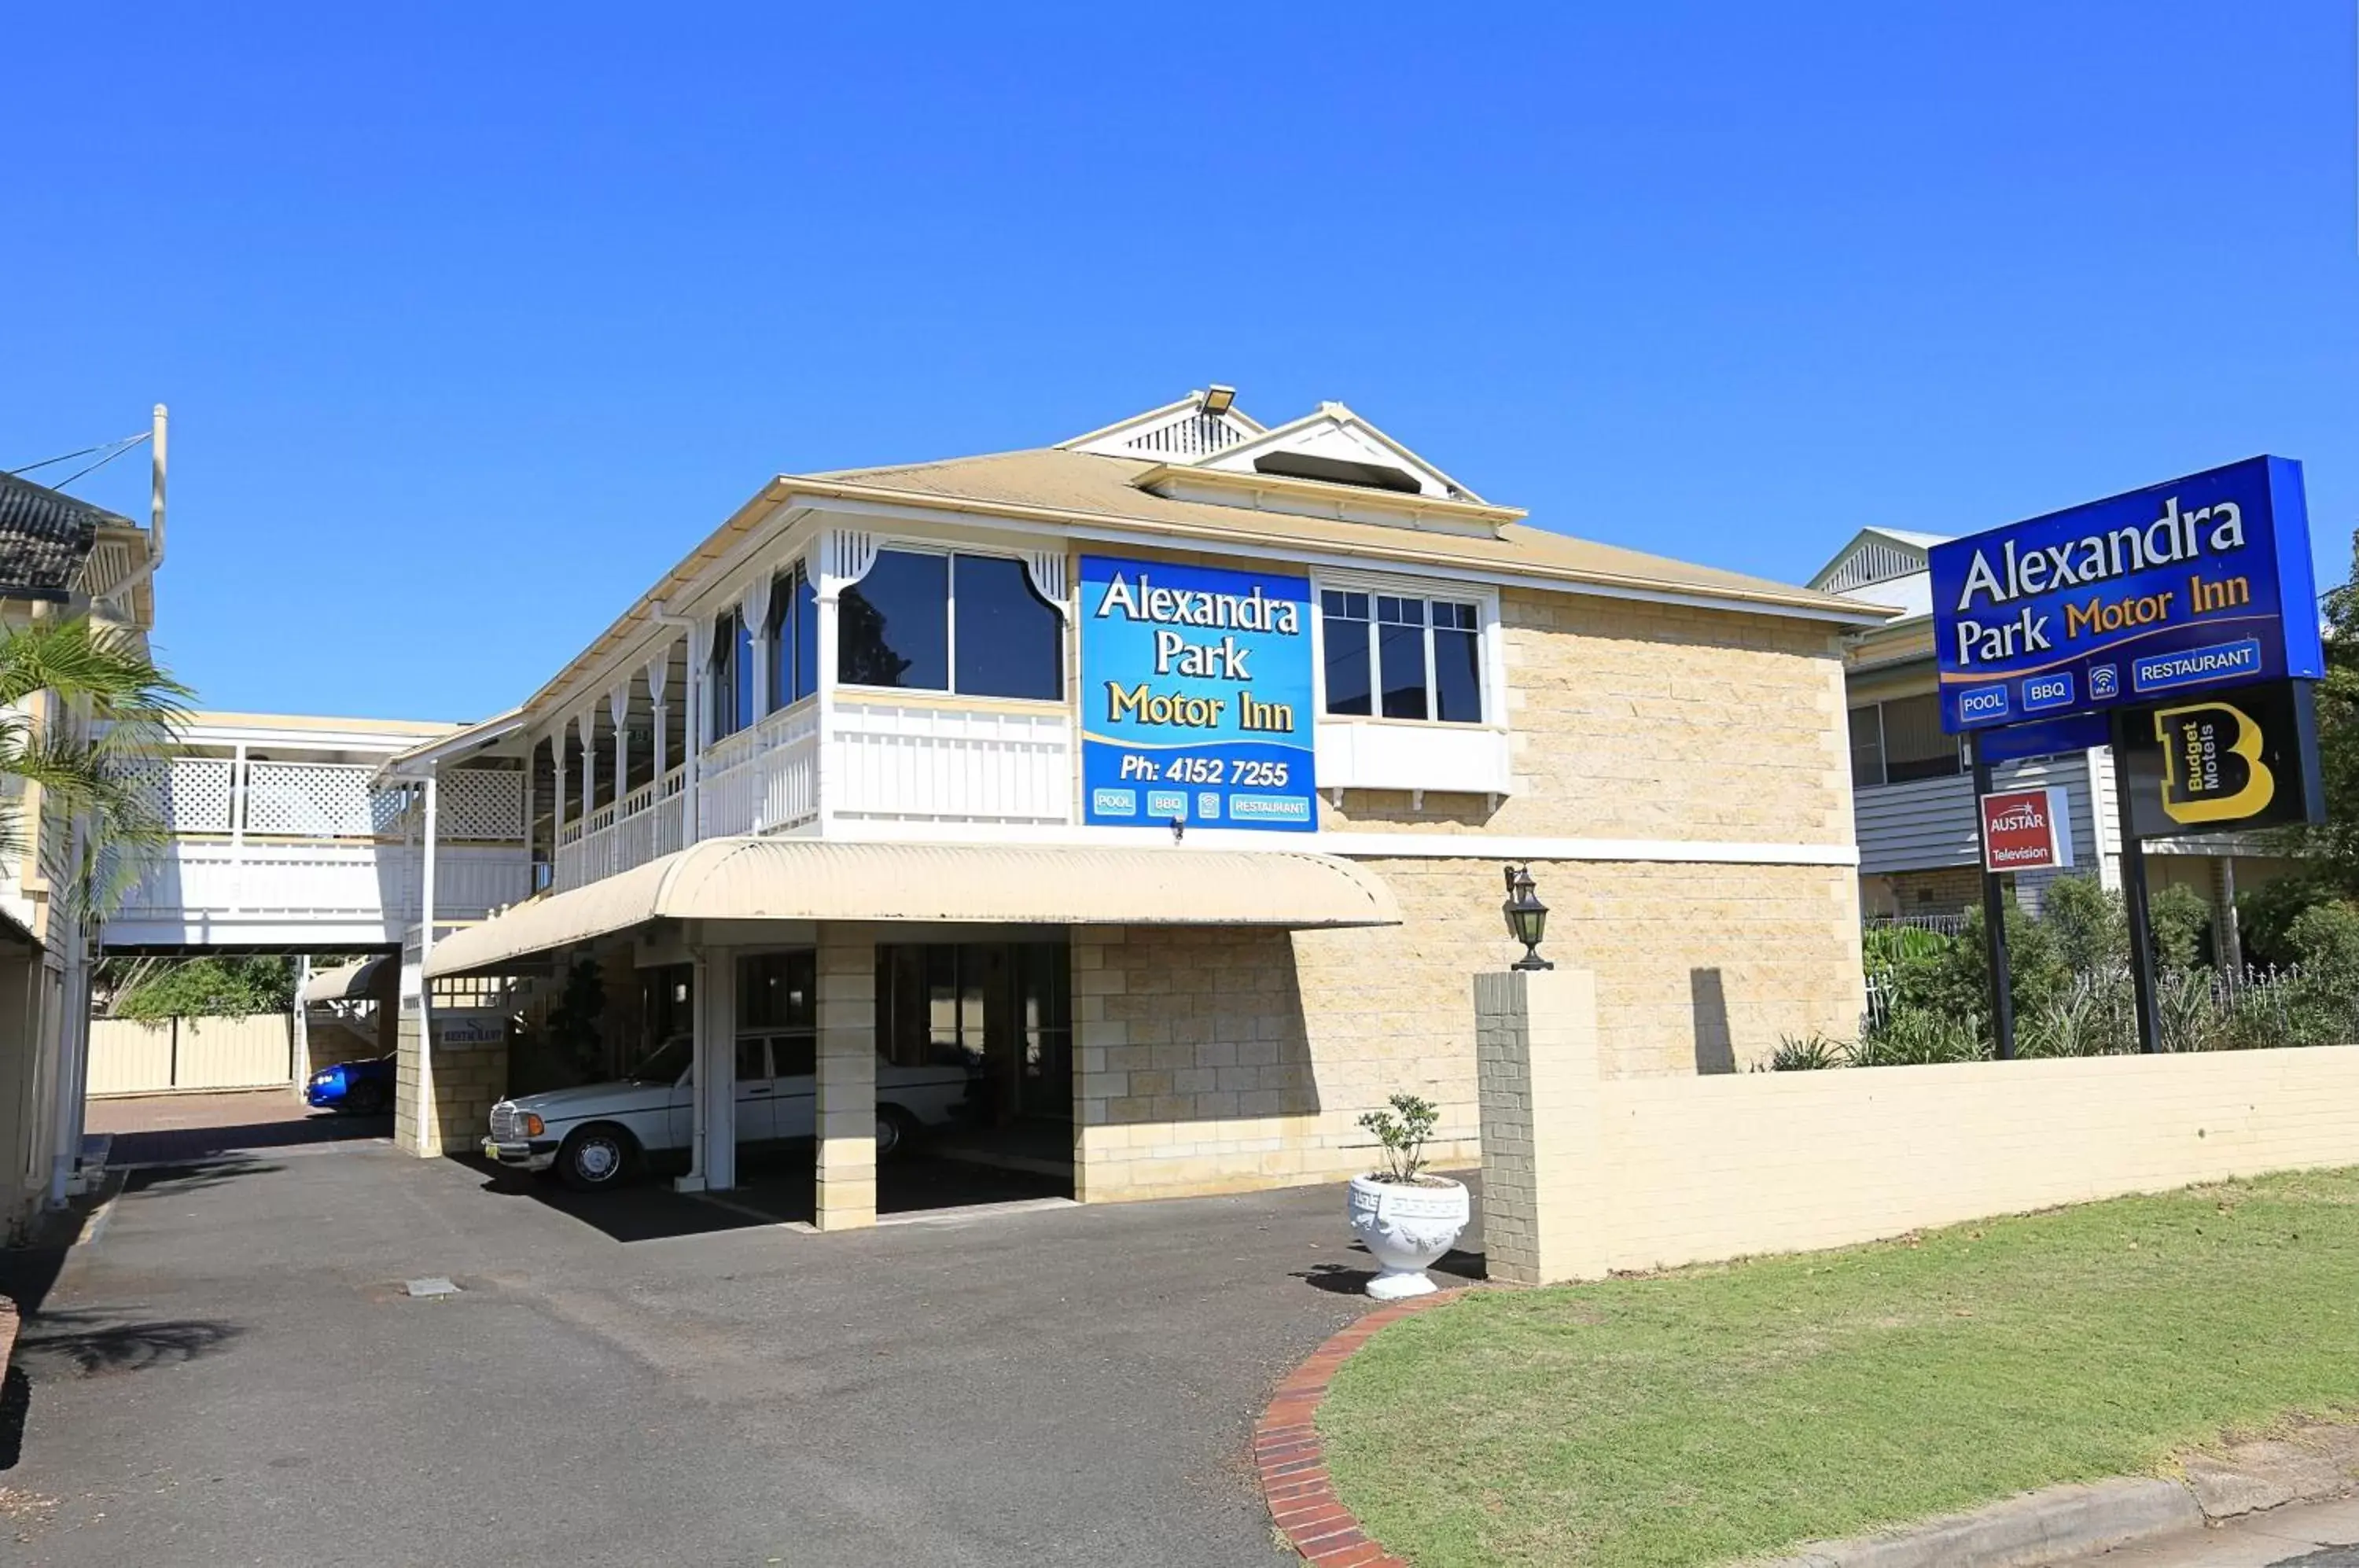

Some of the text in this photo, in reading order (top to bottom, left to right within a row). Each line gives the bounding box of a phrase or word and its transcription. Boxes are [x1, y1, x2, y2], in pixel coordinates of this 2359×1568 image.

[1958, 497, 2245, 610] Alexandra
[1095, 571, 1299, 635] Alexandra
[1956, 576, 2250, 666] Park Motor Inn
[1154, 630, 1253, 681] Park
[2141, 649, 2254, 681] RESTAURANT
[1964, 692, 2005, 713] POOL
[2030, 678, 2066, 701] BBQ
[1104, 681, 1295, 733] Motor Inn
[1120, 755, 1290, 787] Ph: 4152 7255
[2182, 720, 2203, 793] Budget
[2200, 724, 2219, 790] Motels
[1097, 794, 1133, 809] POOL
[1154, 797, 1183, 811] BBQ
[1235, 801, 1306, 815] RESTAURANT
[1990, 813, 2046, 832] AUSTAR
[1992, 846, 2049, 861] Television
